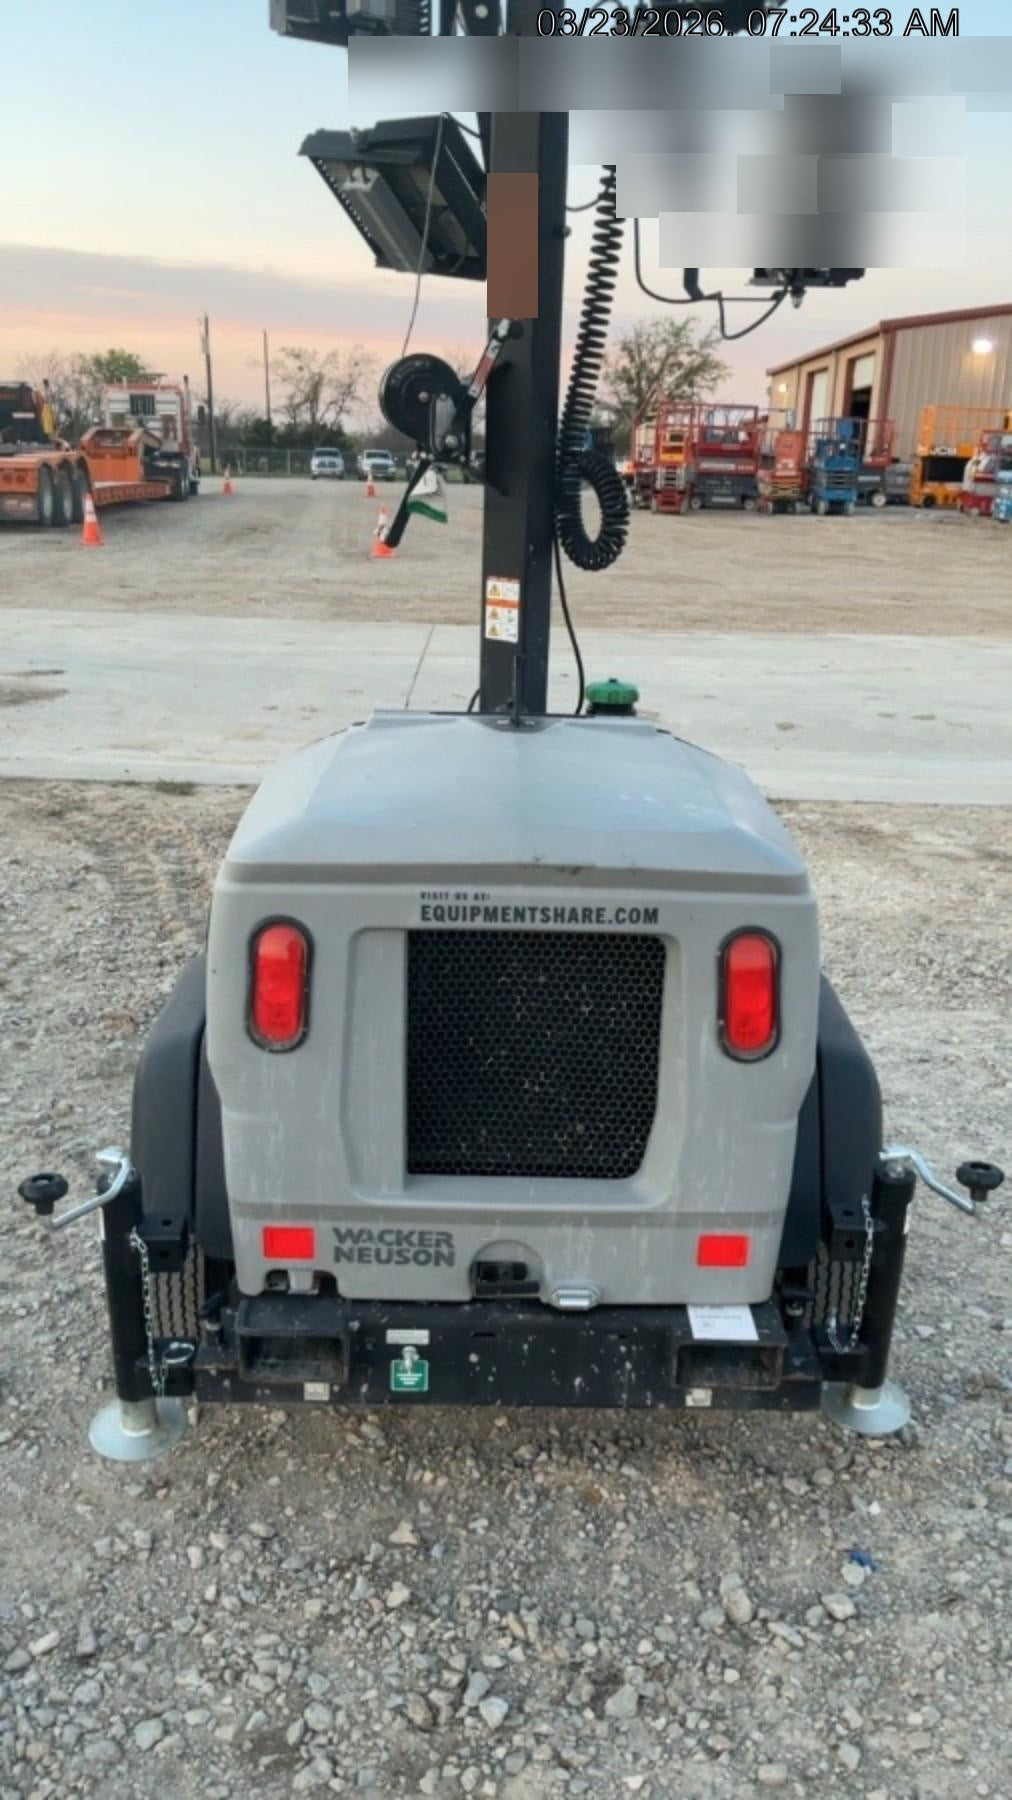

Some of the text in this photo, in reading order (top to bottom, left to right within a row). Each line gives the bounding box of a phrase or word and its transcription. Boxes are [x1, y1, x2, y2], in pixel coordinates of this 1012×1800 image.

[420, 904, 660, 925] EQUIPMENTSHARE.COM
[332, 1227, 456, 1249] WACKER
[333, 1245, 455, 1267] NEUSON
